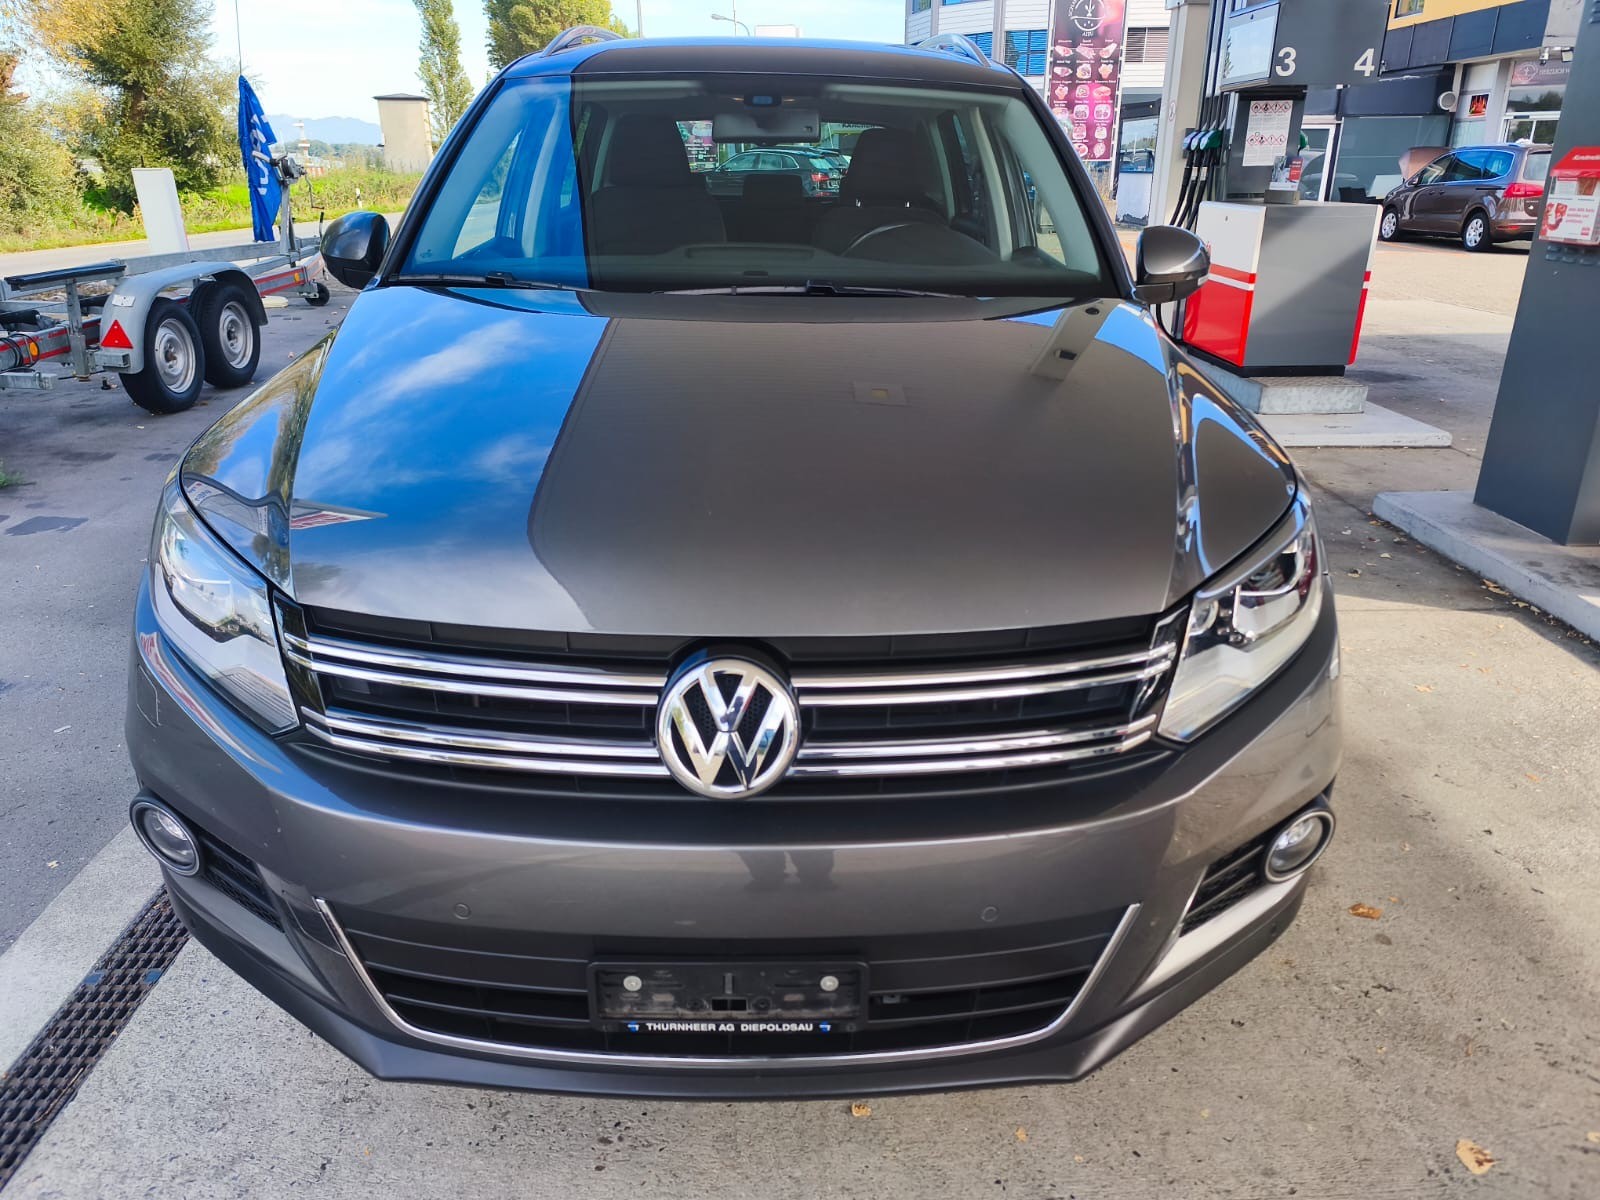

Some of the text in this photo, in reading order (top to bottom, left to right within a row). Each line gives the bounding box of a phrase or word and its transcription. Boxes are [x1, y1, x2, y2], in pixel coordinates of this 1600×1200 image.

[1275, 46, 1297, 77] 3
[1353, 47, 1375, 77] 4
[646, 1022, 814, 1032] THURNHEER AG DIEPOLDSAU
